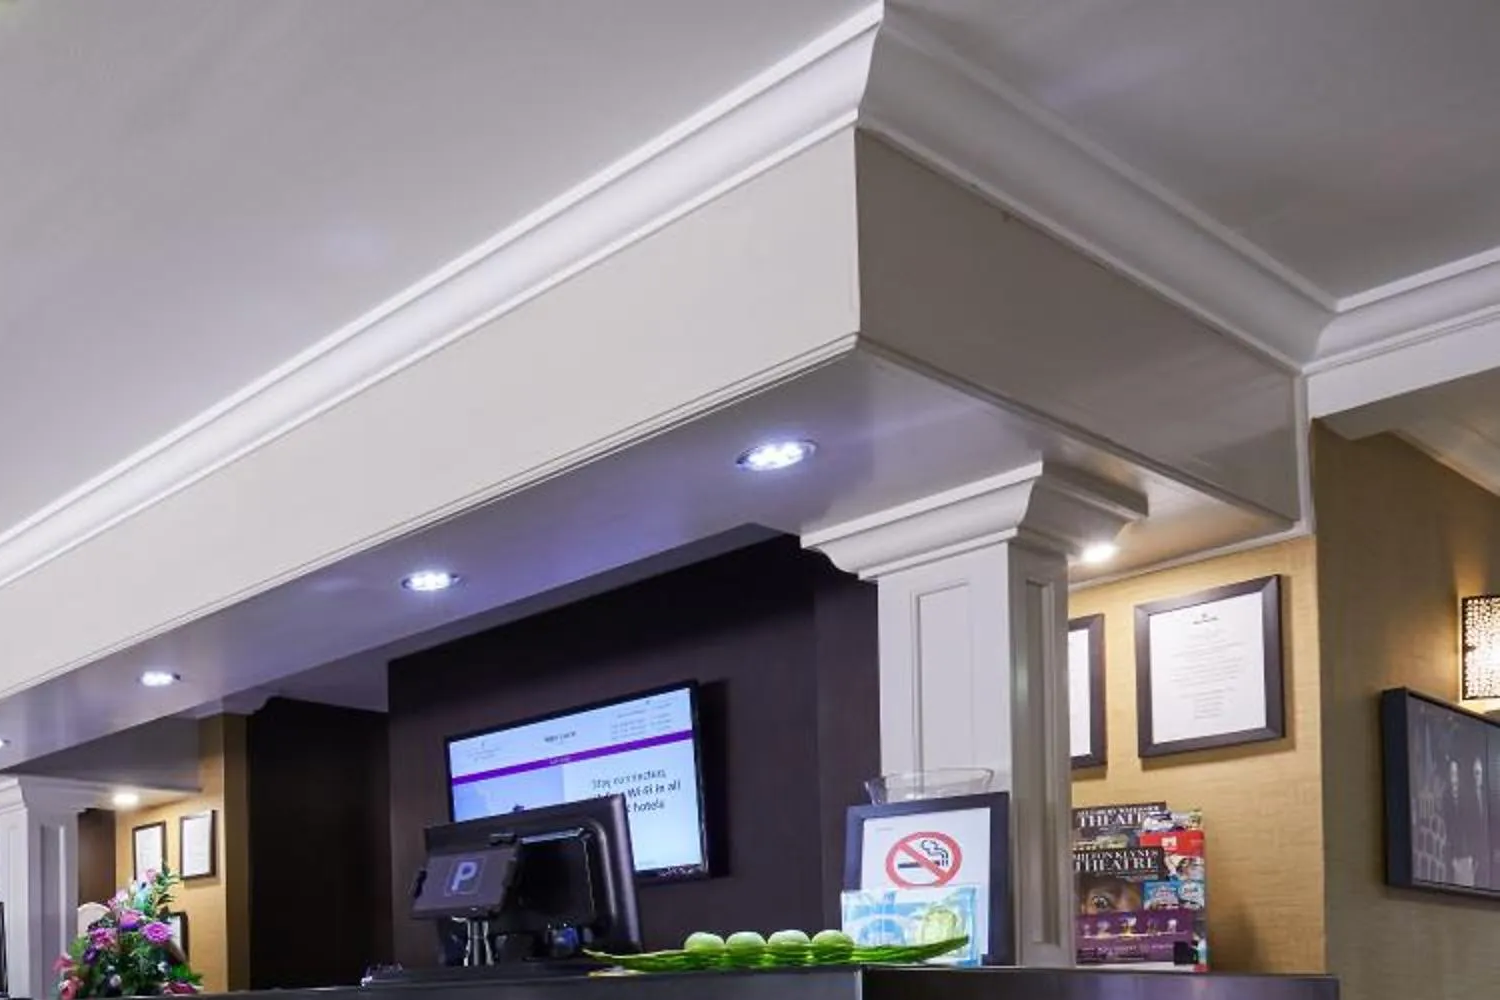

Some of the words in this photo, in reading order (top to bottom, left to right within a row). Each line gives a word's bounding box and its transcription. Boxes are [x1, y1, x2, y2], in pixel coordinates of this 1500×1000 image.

[667, 778, 681, 791] all
[633, 798, 665, 812] hotels
[1079, 811, 1145, 828] THEATR
[1074, 857, 1154, 872] THEATRE
